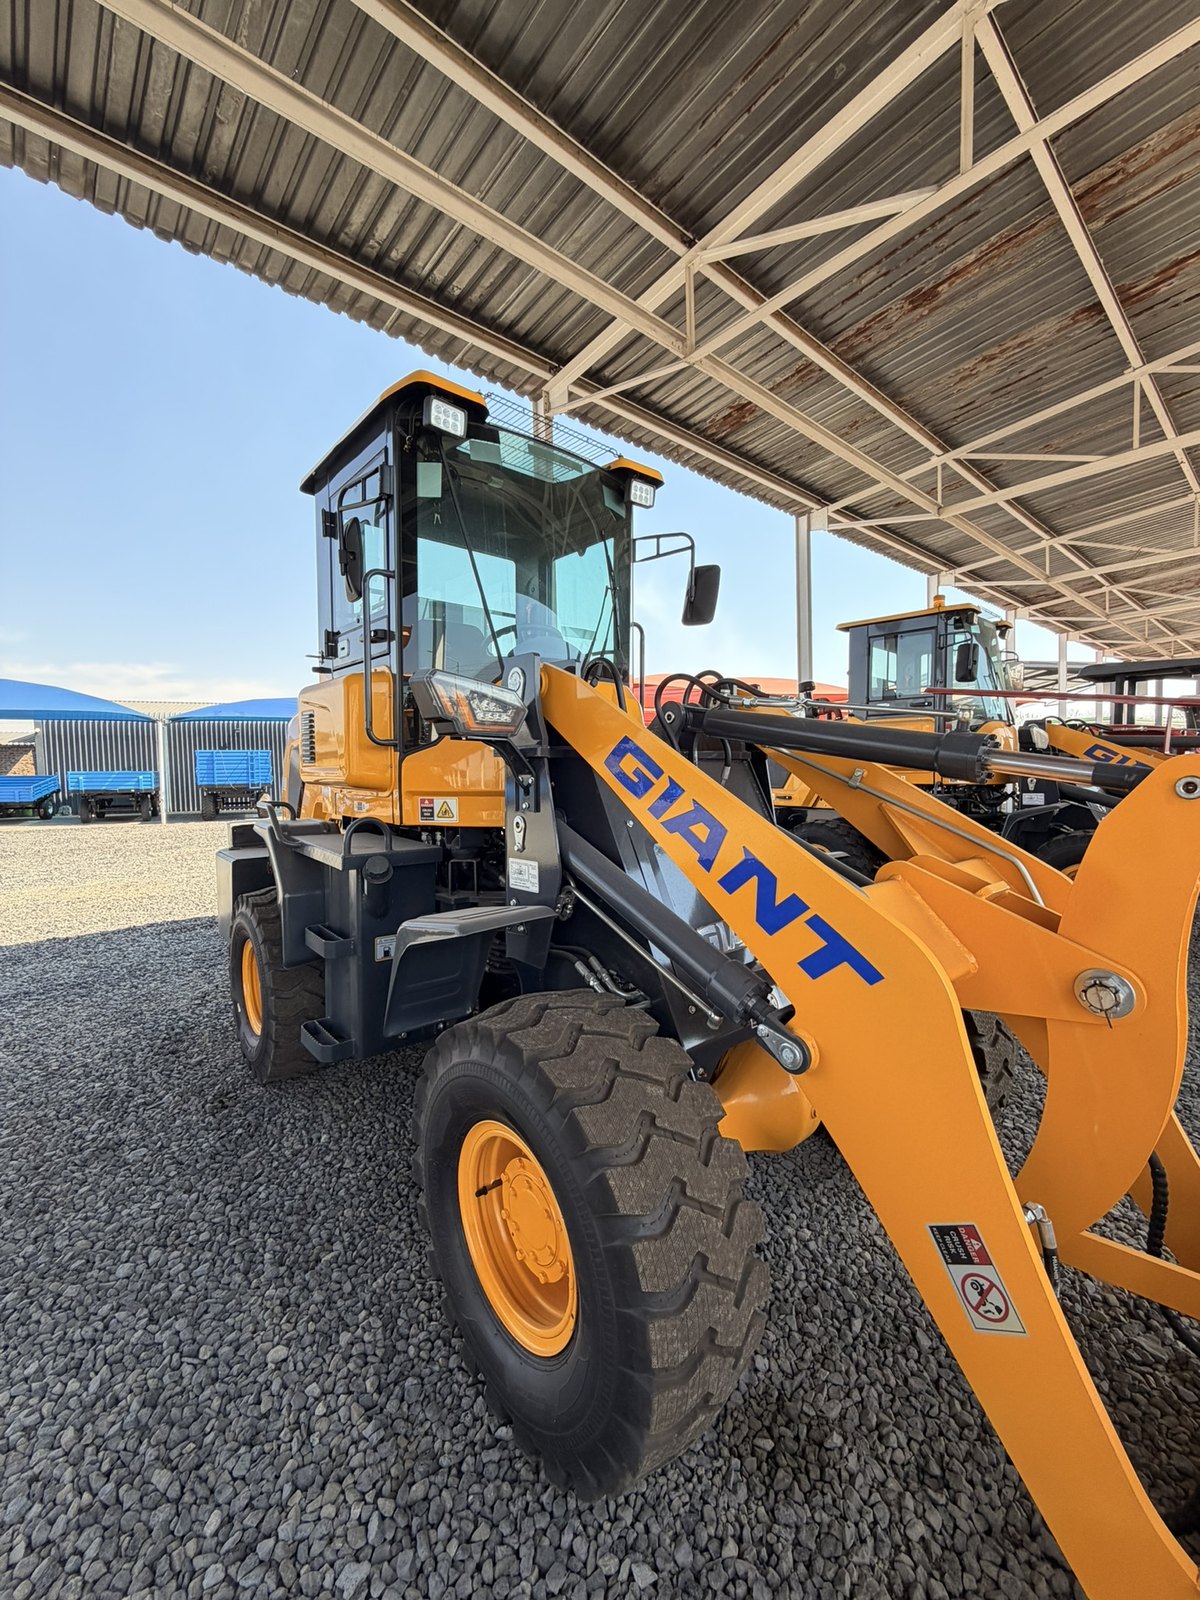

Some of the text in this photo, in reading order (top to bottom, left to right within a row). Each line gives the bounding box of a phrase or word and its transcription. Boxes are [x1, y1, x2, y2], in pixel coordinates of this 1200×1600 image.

[1083, 743, 1155, 770] GI
[603, 735, 886, 987] GIANT
[932, 1227, 952, 1263] KEEP CLEAR
[944, 1235, 958, 1254] RISK
[949, 1230, 968, 1259] CRUSH
[957, 1227, 980, 1264] DANGER
